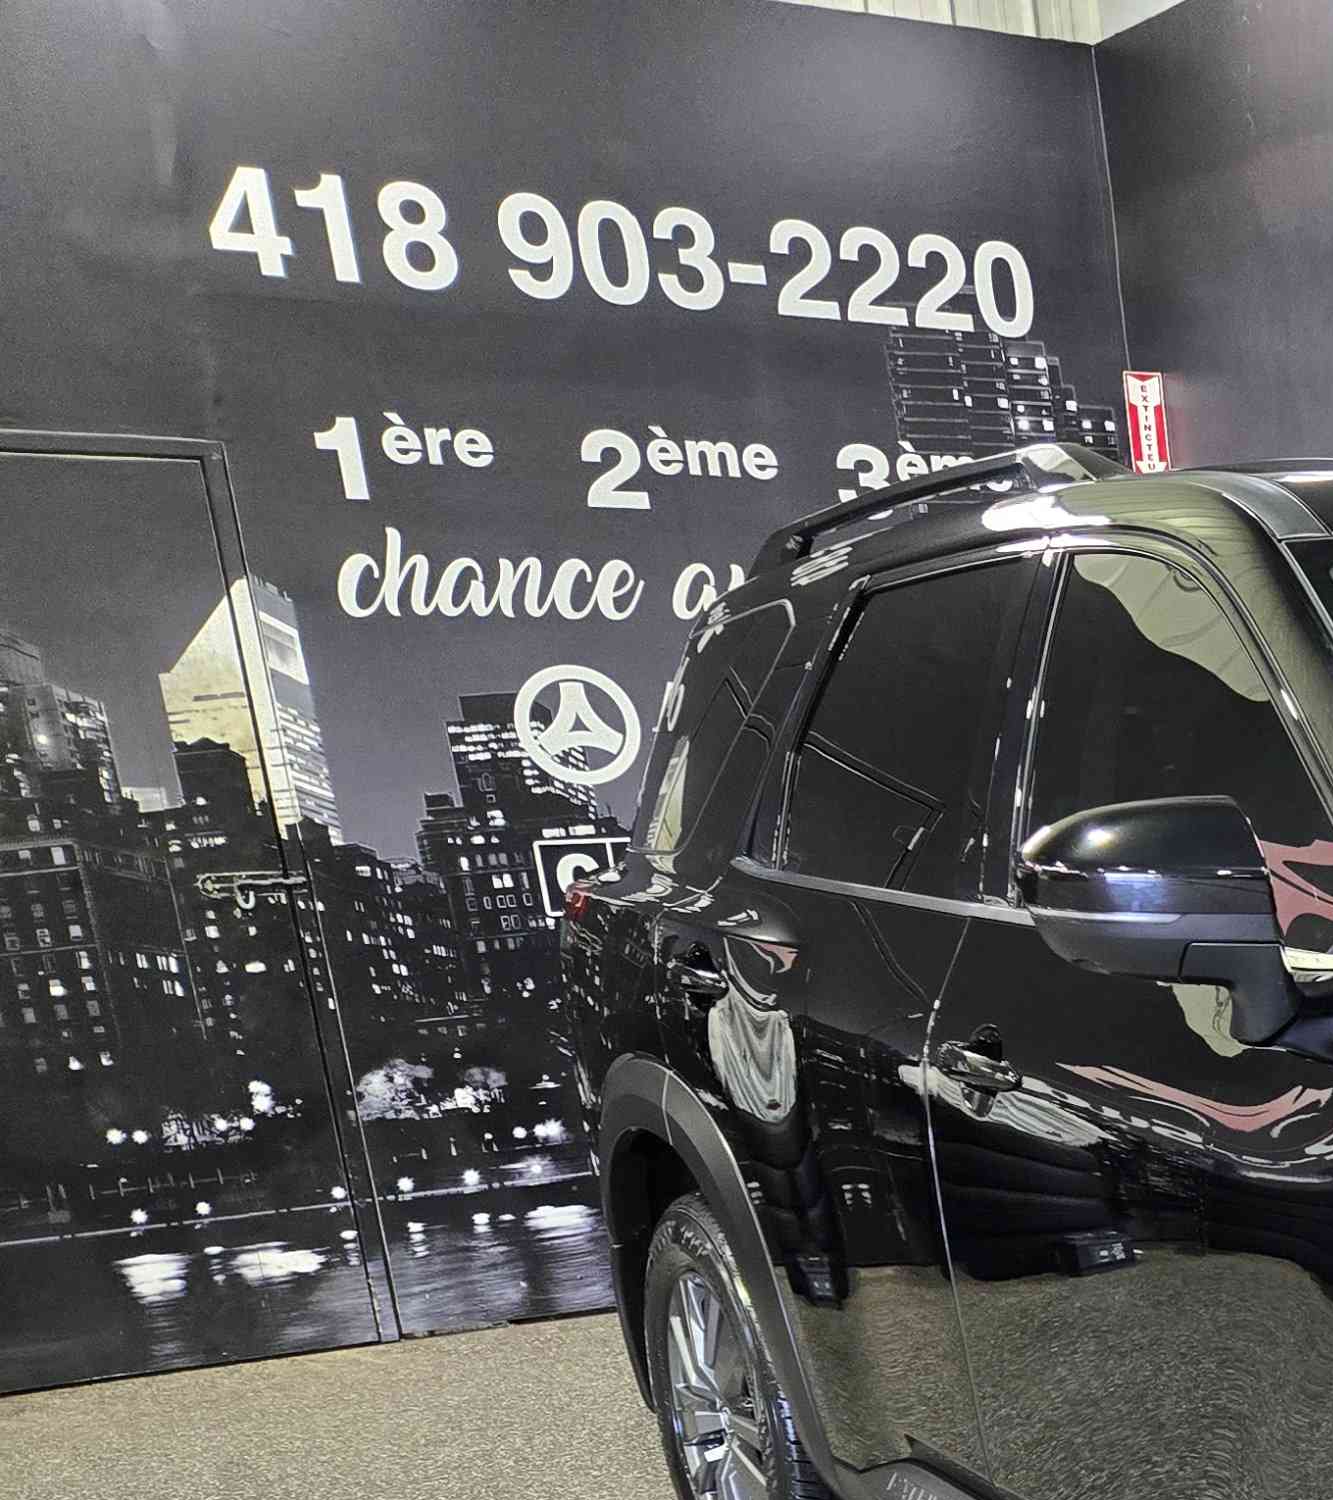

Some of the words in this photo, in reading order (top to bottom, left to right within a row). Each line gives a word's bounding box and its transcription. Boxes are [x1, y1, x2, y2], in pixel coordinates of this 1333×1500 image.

[209, 166, 459, 291] 418
[497, 191, 1034, 338] 903-2220
[313, 411, 494, 501] 1ère
[580, 425, 779, 510] 2ème
[337, 526, 645, 620] chance
